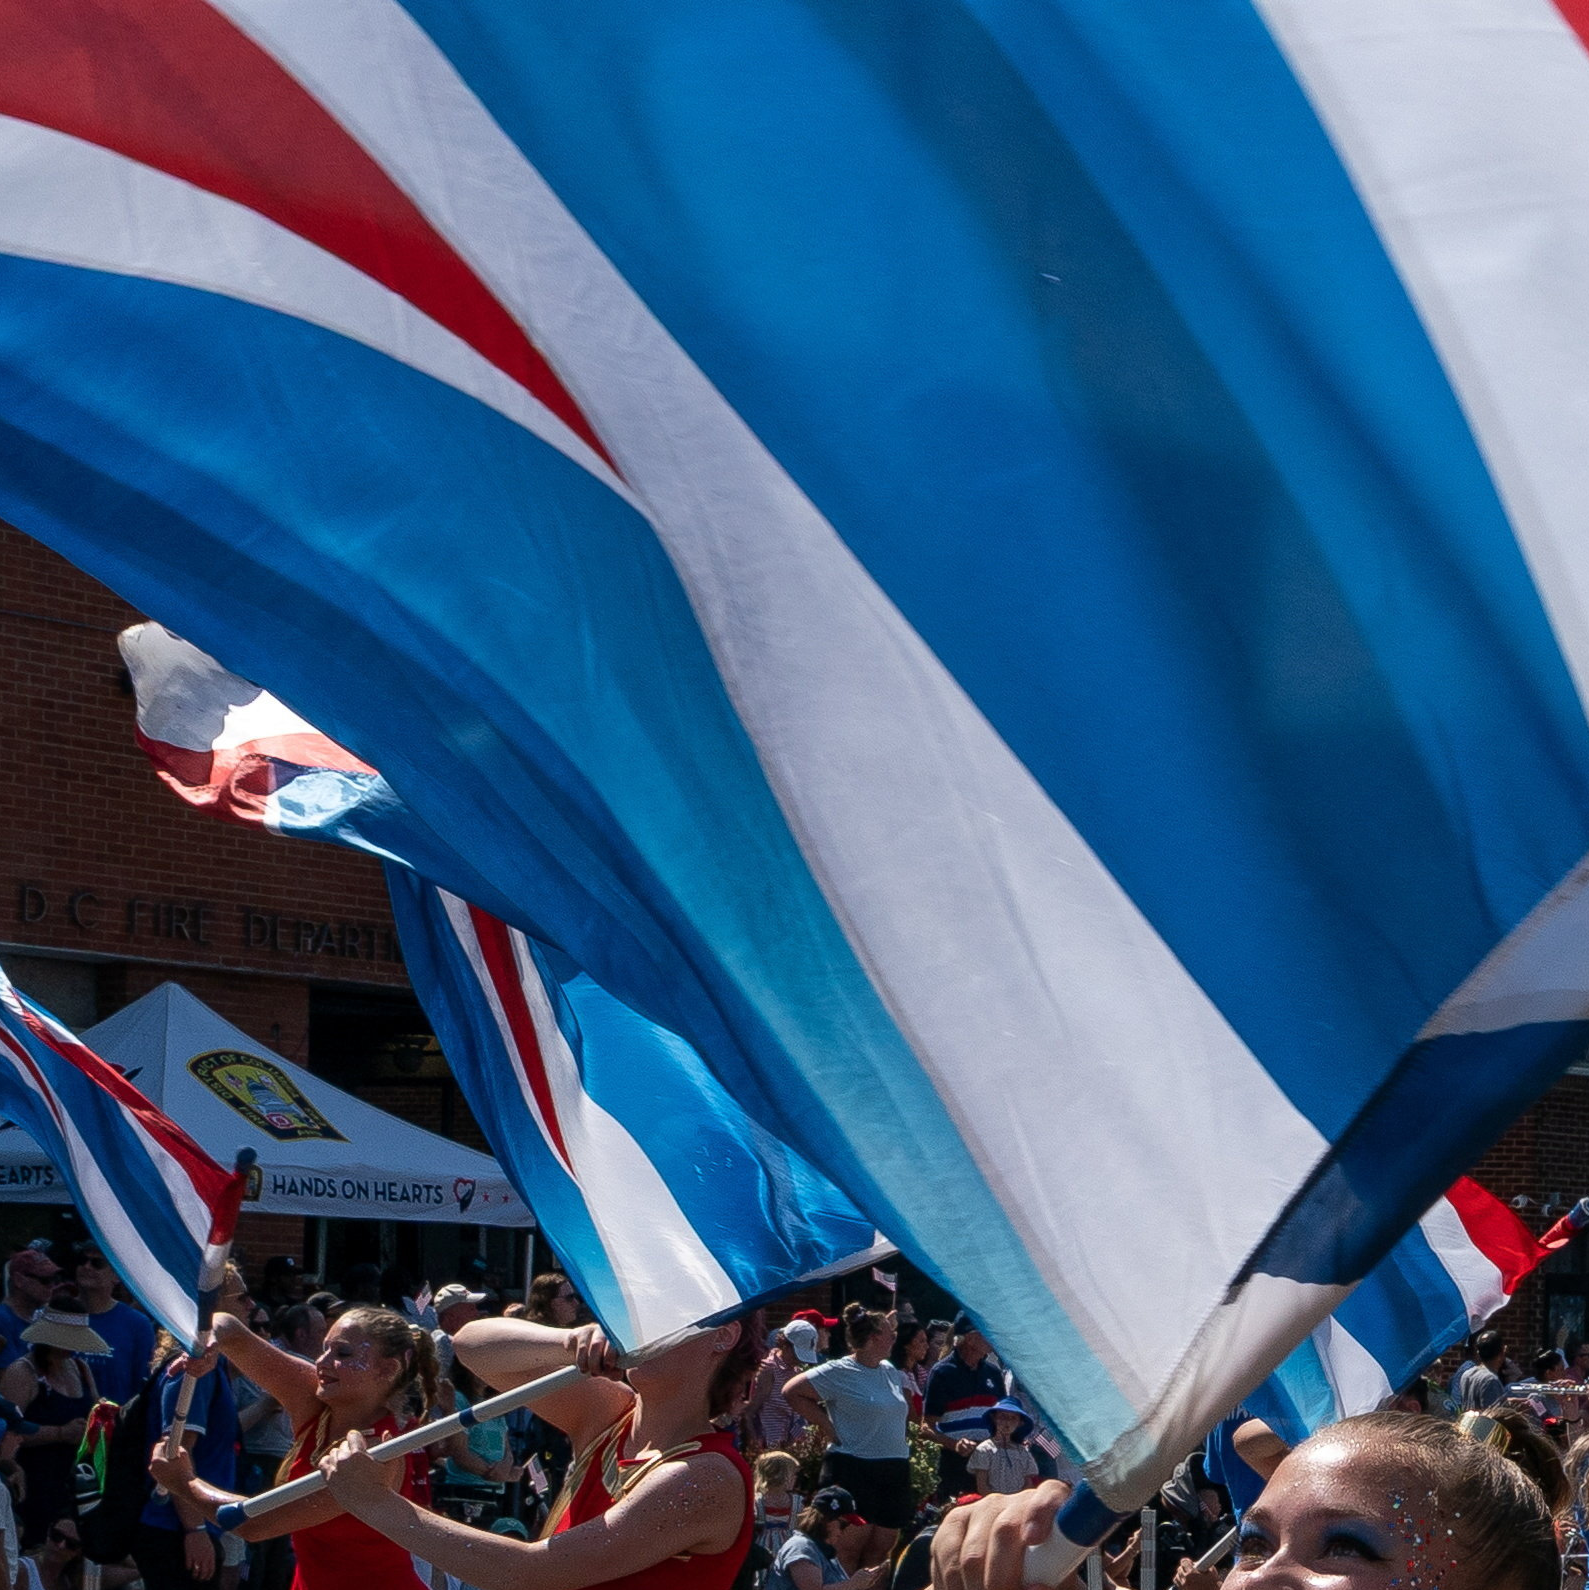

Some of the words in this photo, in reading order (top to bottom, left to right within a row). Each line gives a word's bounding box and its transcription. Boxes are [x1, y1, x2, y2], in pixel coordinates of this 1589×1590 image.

[72, 891, 100, 929] C
[131, 899, 214, 944] FIRE
[246, 911, 400, 962] DEPART
[272, 1175, 338, 1198] HANDS
[341, 1179, 369, 1200] ON
[374, 1181, 444, 1204] HEARTS
